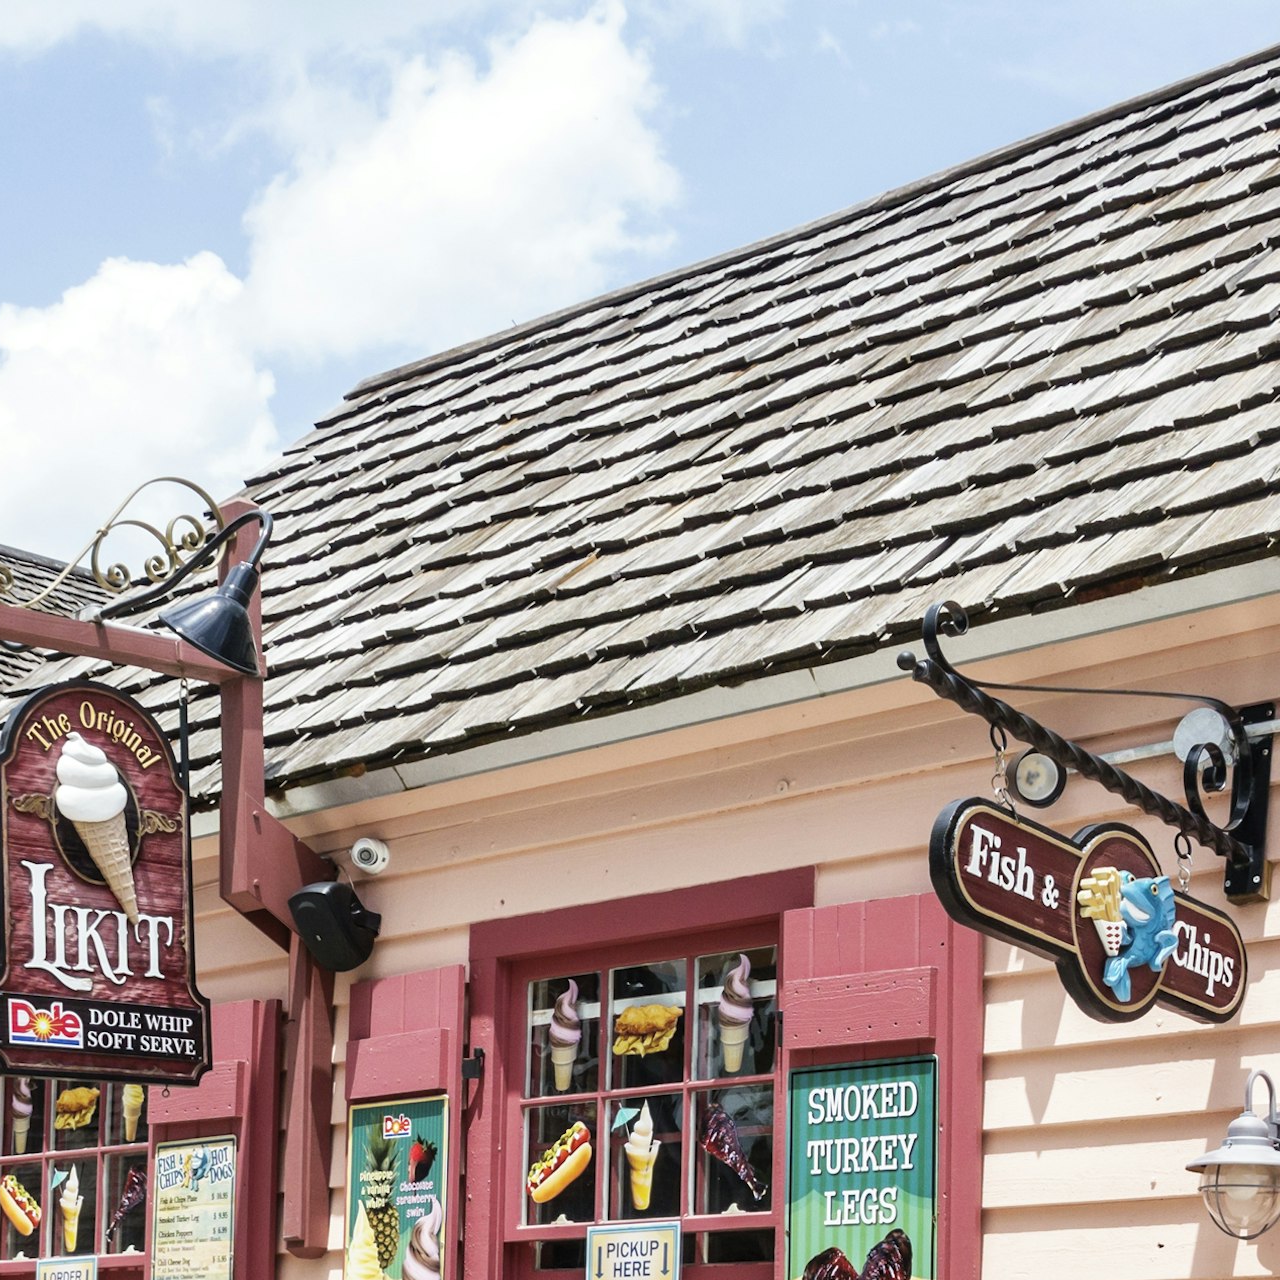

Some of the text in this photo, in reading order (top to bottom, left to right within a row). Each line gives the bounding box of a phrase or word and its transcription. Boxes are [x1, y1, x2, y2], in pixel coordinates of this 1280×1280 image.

[26, 701, 162, 769] The Original
[964, 824, 1235, 998] Fish & Chips
[11, 1001, 81, 1038] Dole
[88, 1008, 194, 1034] DOLE WHIP
[87, 1030, 197, 1056] SOFT SERVE
[808, 1080, 919, 1125] SMOKED
[384, 1115, 410, 1133] Dole
[158, 1154, 176, 1174] FISH
[210, 1147, 228, 1166] HOT
[806, 1133, 918, 1176] TURKEY
[159, 1169, 184, 1190] CHIPS
[210, 1163, 233, 1184] DOGS
[399, 1181, 434, 1192] chocolate
[396, 1193, 437, 1206] strawberry
[824, 1187, 899, 1227] LEGS
[606, 1240, 660, 1258] PICKUP
[613, 1260, 651, 1278] HERE
